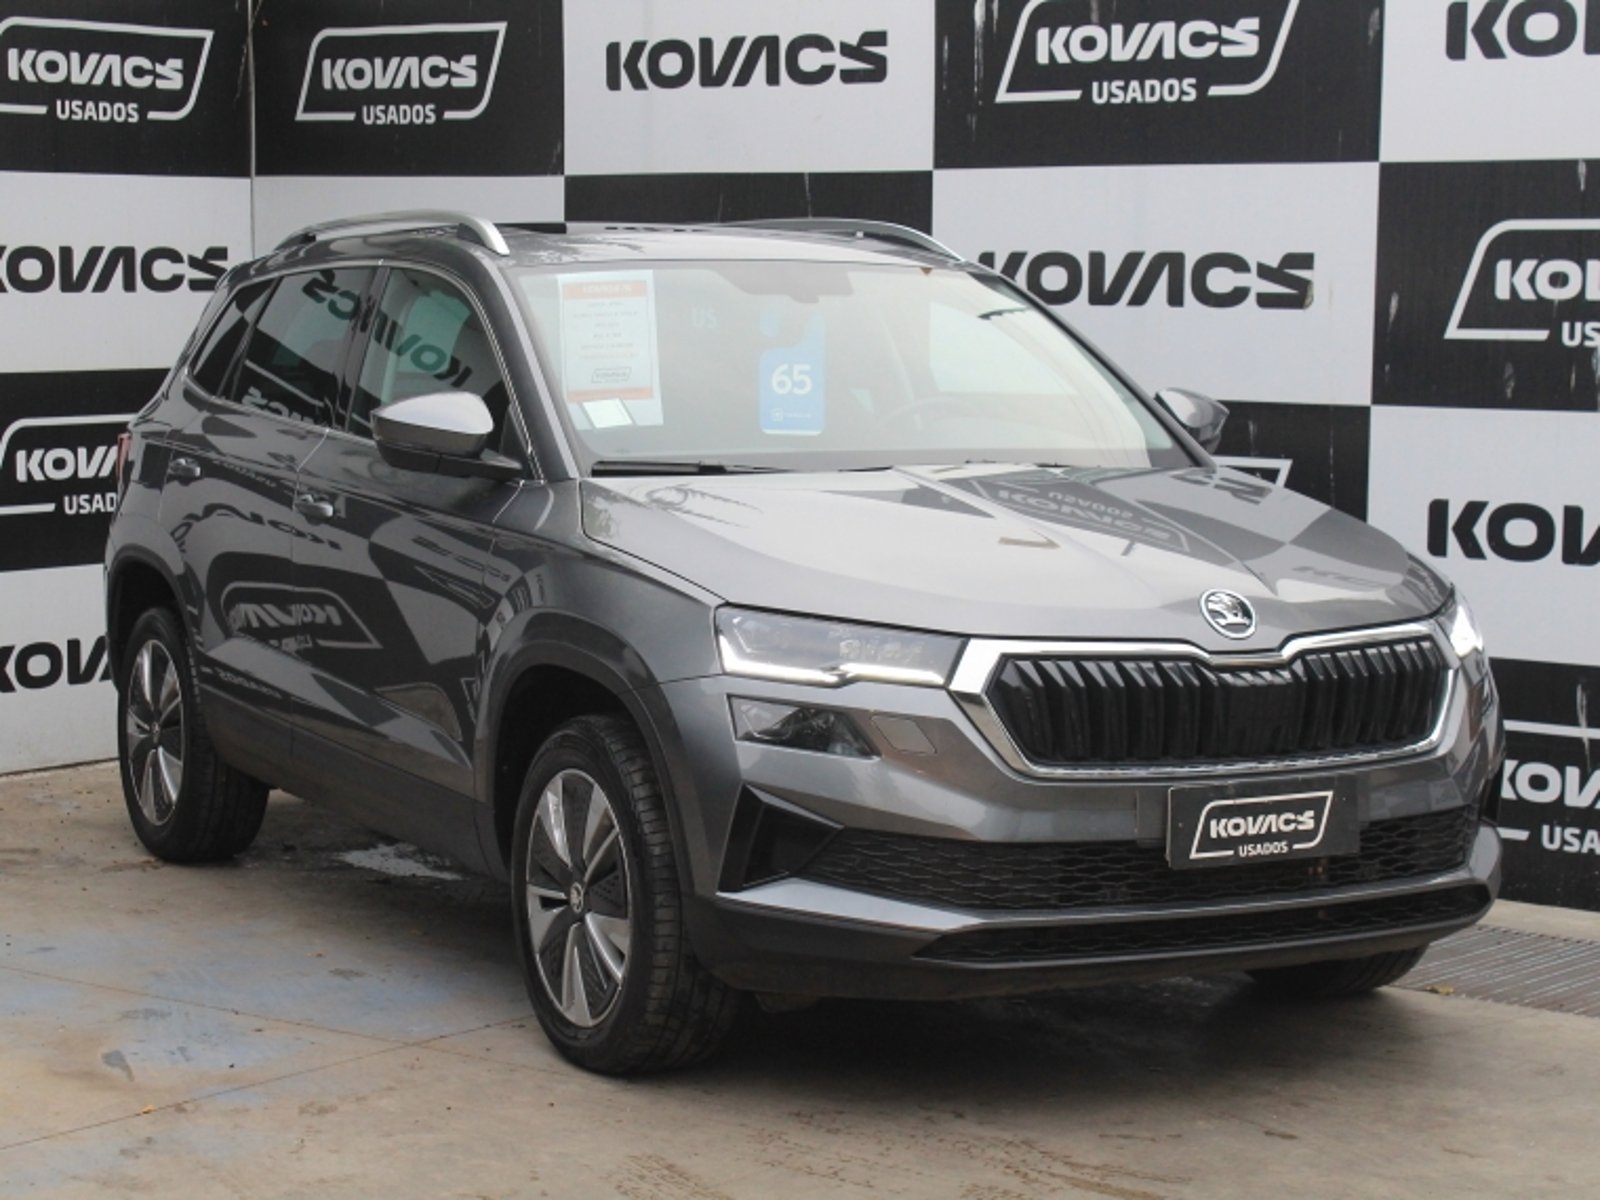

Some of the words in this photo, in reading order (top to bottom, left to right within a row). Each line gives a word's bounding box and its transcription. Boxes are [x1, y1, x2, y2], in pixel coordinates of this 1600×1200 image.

[1037, 18, 1259, 64] KOVACS
[8, 48, 183, 89] KOVACS
[323, 55, 476, 89] KOVACS
[606, 31, 887, 91] KOVACS
[1093, 78, 1196, 104] USADOS
[57, 100, 138, 122] USADOS
[363, 104, 435, 124] USADOS
[0, 246, 228, 293] OVACS
[772, 364, 812, 394] 65
[0, 636, 112, 693] OV
[1210, 810, 1314, 838] KOVACS
[1239, 841, 1288, 857] USADOS
[1542, 825, 1600, 854] USA
